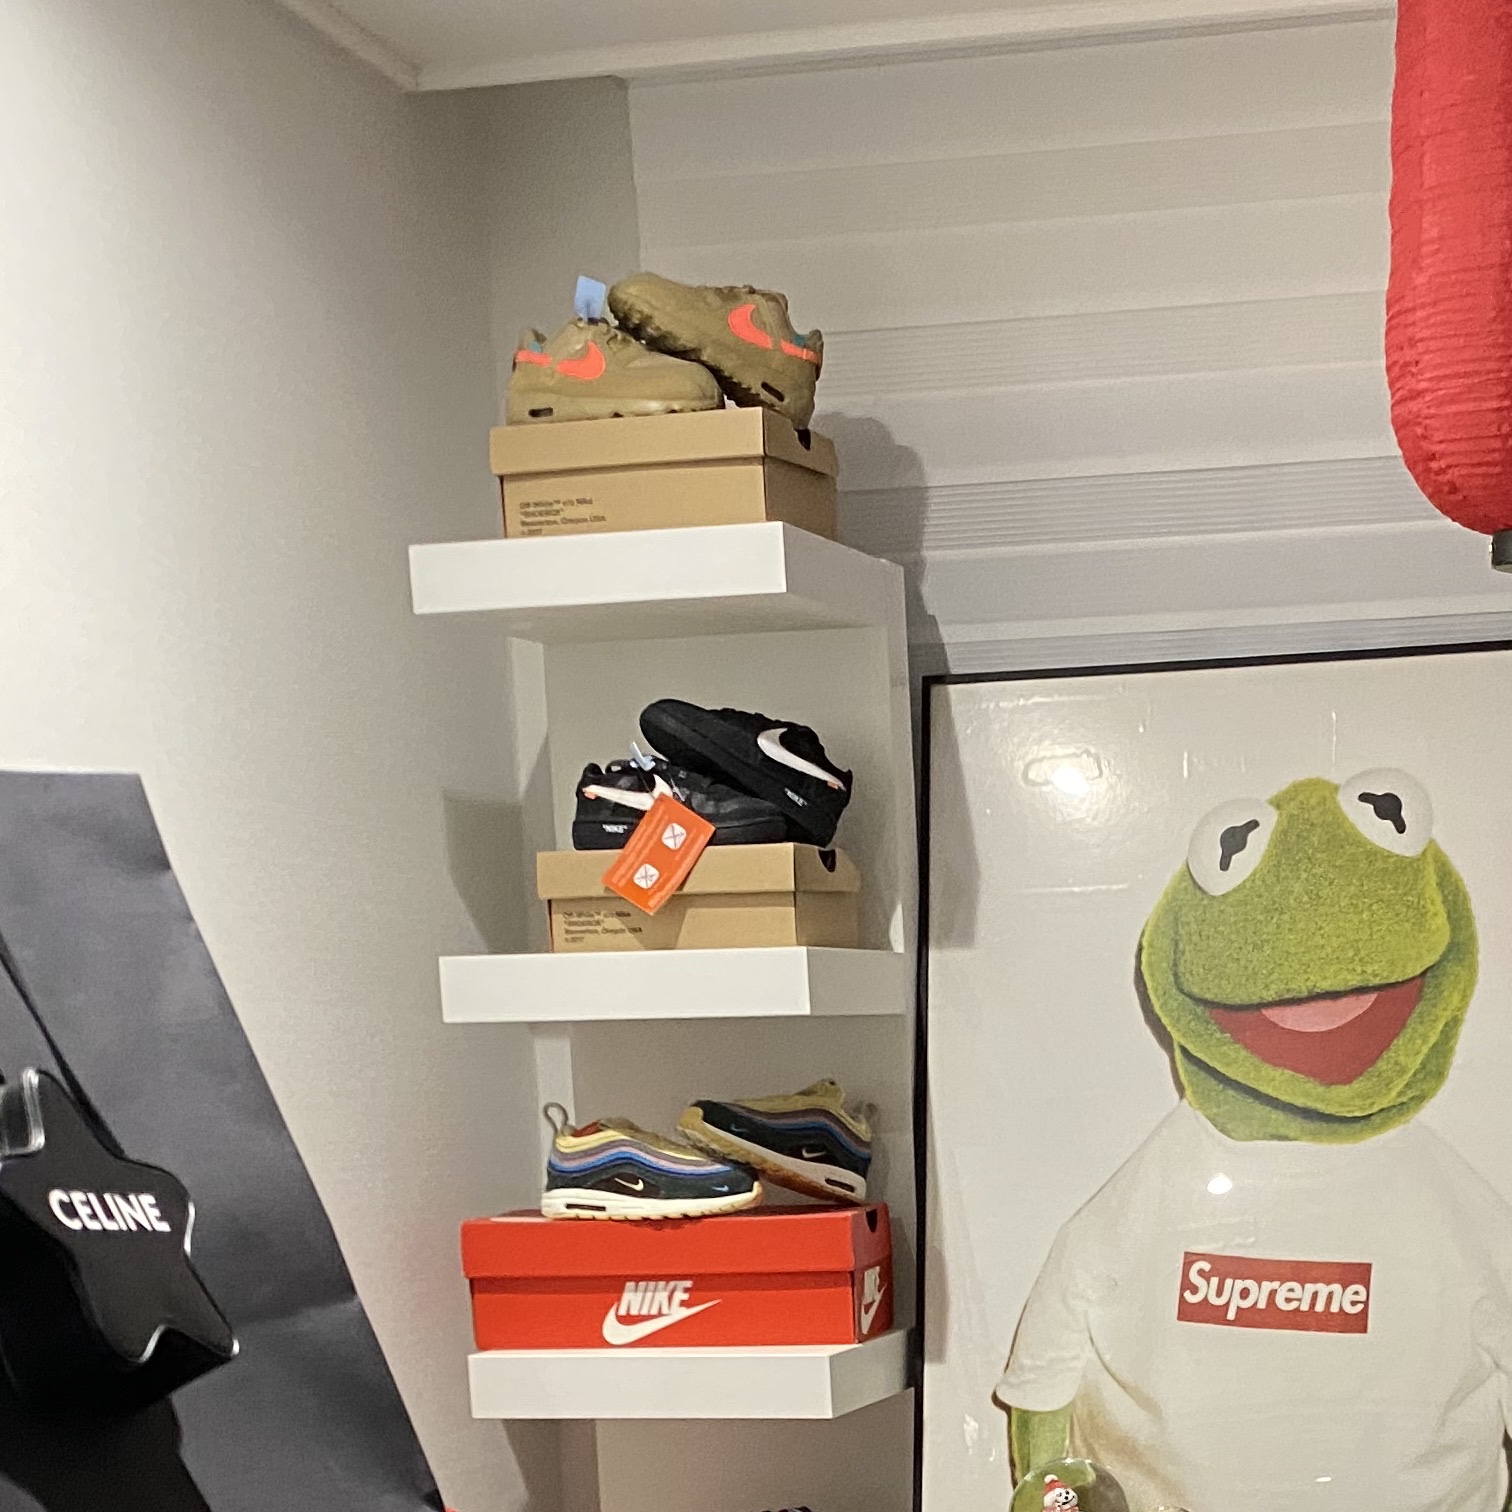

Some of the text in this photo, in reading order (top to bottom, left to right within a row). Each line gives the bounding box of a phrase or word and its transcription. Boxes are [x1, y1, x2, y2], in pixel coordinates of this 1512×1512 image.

[49, 1188, 171, 1232] CELINE
[617, 1280, 693, 1316] NIKE
[1183, 1260, 1367, 1321] Supreme
